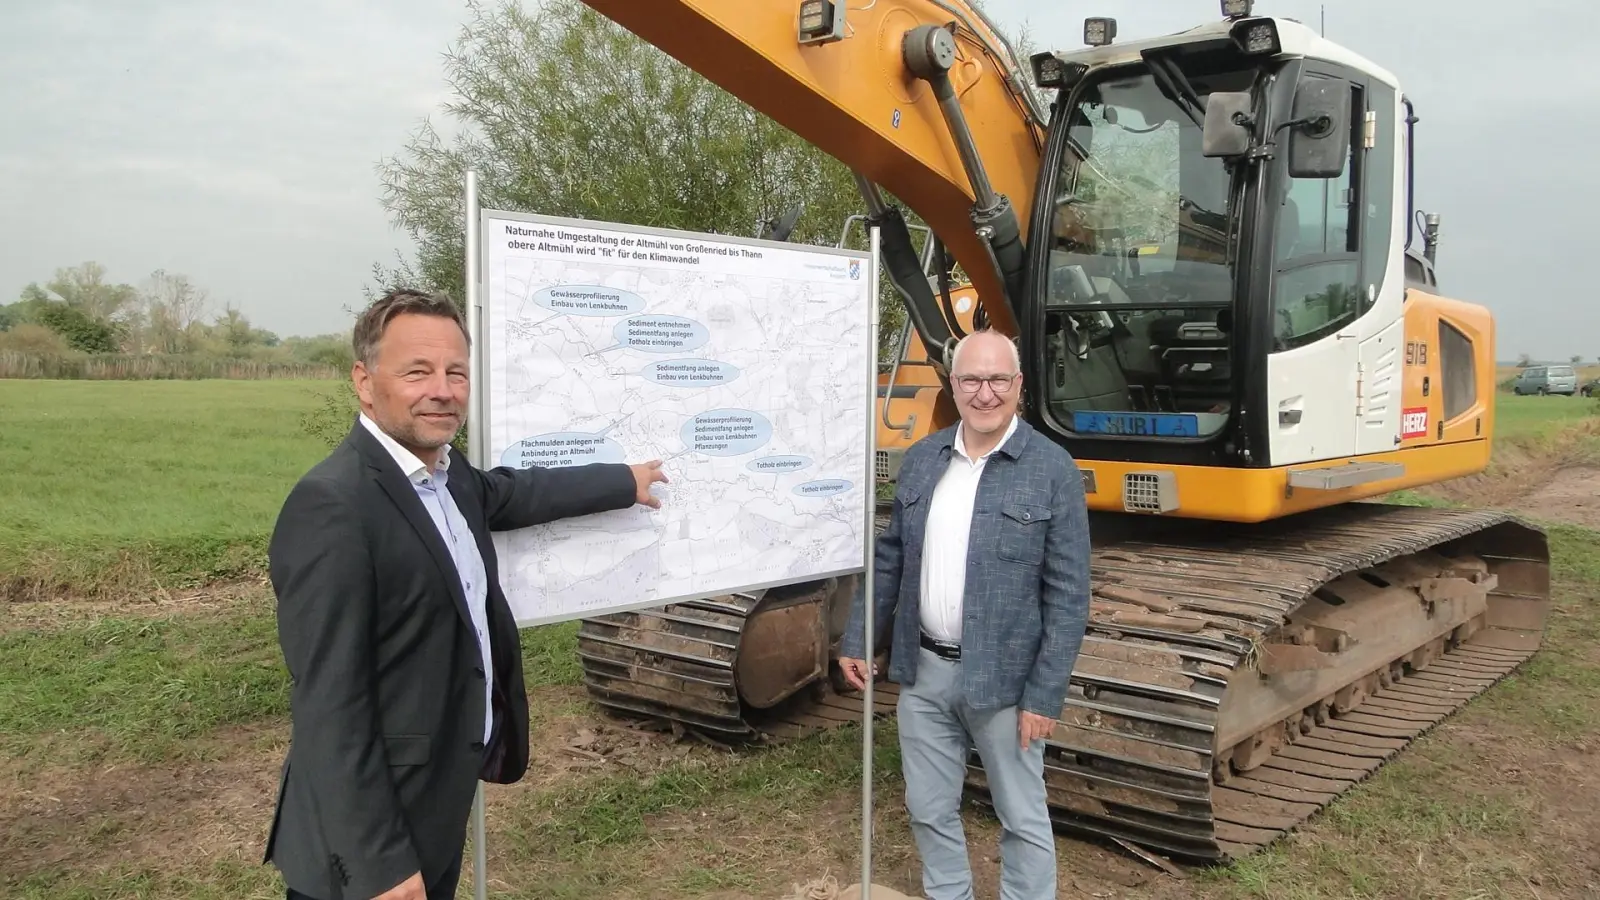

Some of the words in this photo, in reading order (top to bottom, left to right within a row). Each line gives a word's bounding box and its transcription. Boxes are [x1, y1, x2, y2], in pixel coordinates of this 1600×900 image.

[505, 225, 555, 239] Naturnahe
[557, 230, 618, 247] Umgestaltung
[620, 237, 634, 246] der
[636, 238, 668, 250] Altmühl
[669, 243, 684, 251] von
[685, 244, 727, 256] Großenried
[729, 247, 739, 256] bis
[741, 249, 763, 259] Thann
[508, 240, 535, 250] obere
[538, 242, 573, 254] Altmühl
[576, 246, 596, 256] wird
[598, 247, 615, 257] "fit"
[618, 249, 630, 259] für
[632, 251, 647, 260] den
[649, 253, 700, 265] Klimawandel
[550, 290, 620, 302] Gewässerprofilierung
[551, 299, 574, 309] Einbau
[589, 301, 628, 311] Lenkbuhnen
[628, 319, 656, 328] Sediment
[657, 321, 691, 329] entnehmen
[628, 329, 670, 339] Sedimentfang
[670, 330, 694, 339] anlegen
[628, 338, 650, 346] Totholz
[651, 339, 683, 348] einbringen
[656, 364, 697, 374] Sedimentfang
[697, 364, 720, 374] anlegen
[657, 373, 676, 381] Einbau
[689, 373, 724, 381] Lenkbuhnen
[1403, 412, 1427, 434] HERZ
[694, 425, 732, 433] Sedimentfang
[521, 439, 565, 448] Flachmulden
[566, 438, 592, 446] anlegen
[521, 449, 558, 458] Anbindung
[521, 459, 558, 467] Einbringen
